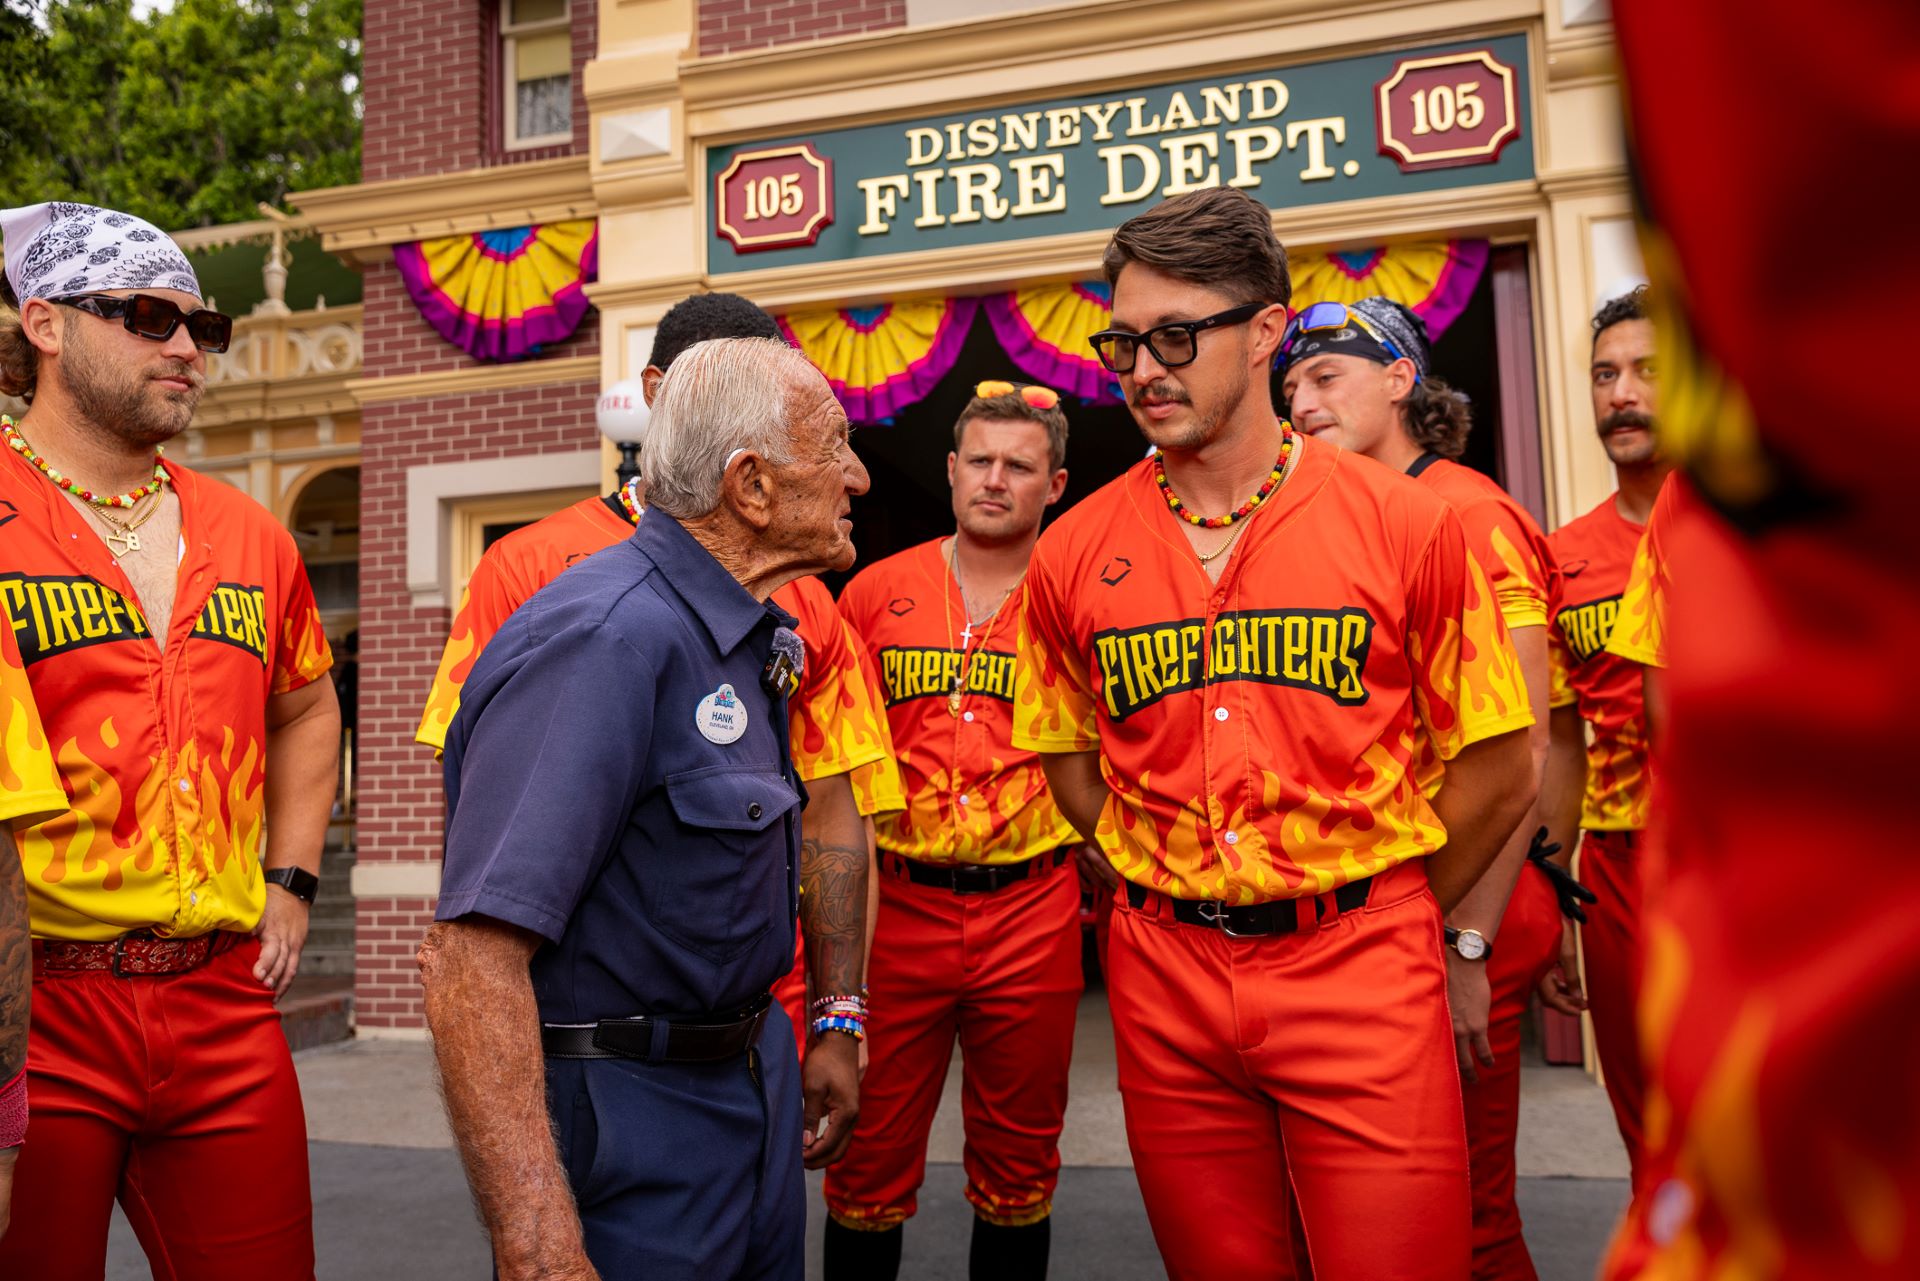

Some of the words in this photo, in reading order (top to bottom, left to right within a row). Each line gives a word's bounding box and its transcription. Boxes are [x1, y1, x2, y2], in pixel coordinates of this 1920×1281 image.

[905, 79, 1289, 167] DISNEYLAND
[1410, 81, 1485, 135] 105
[743, 172, 804, 221] 105
[857, 153, 1067, 235] FIRE
[1098, 116, 1360, 205] DEPT.
[711, 711, 733, 724] HANK
